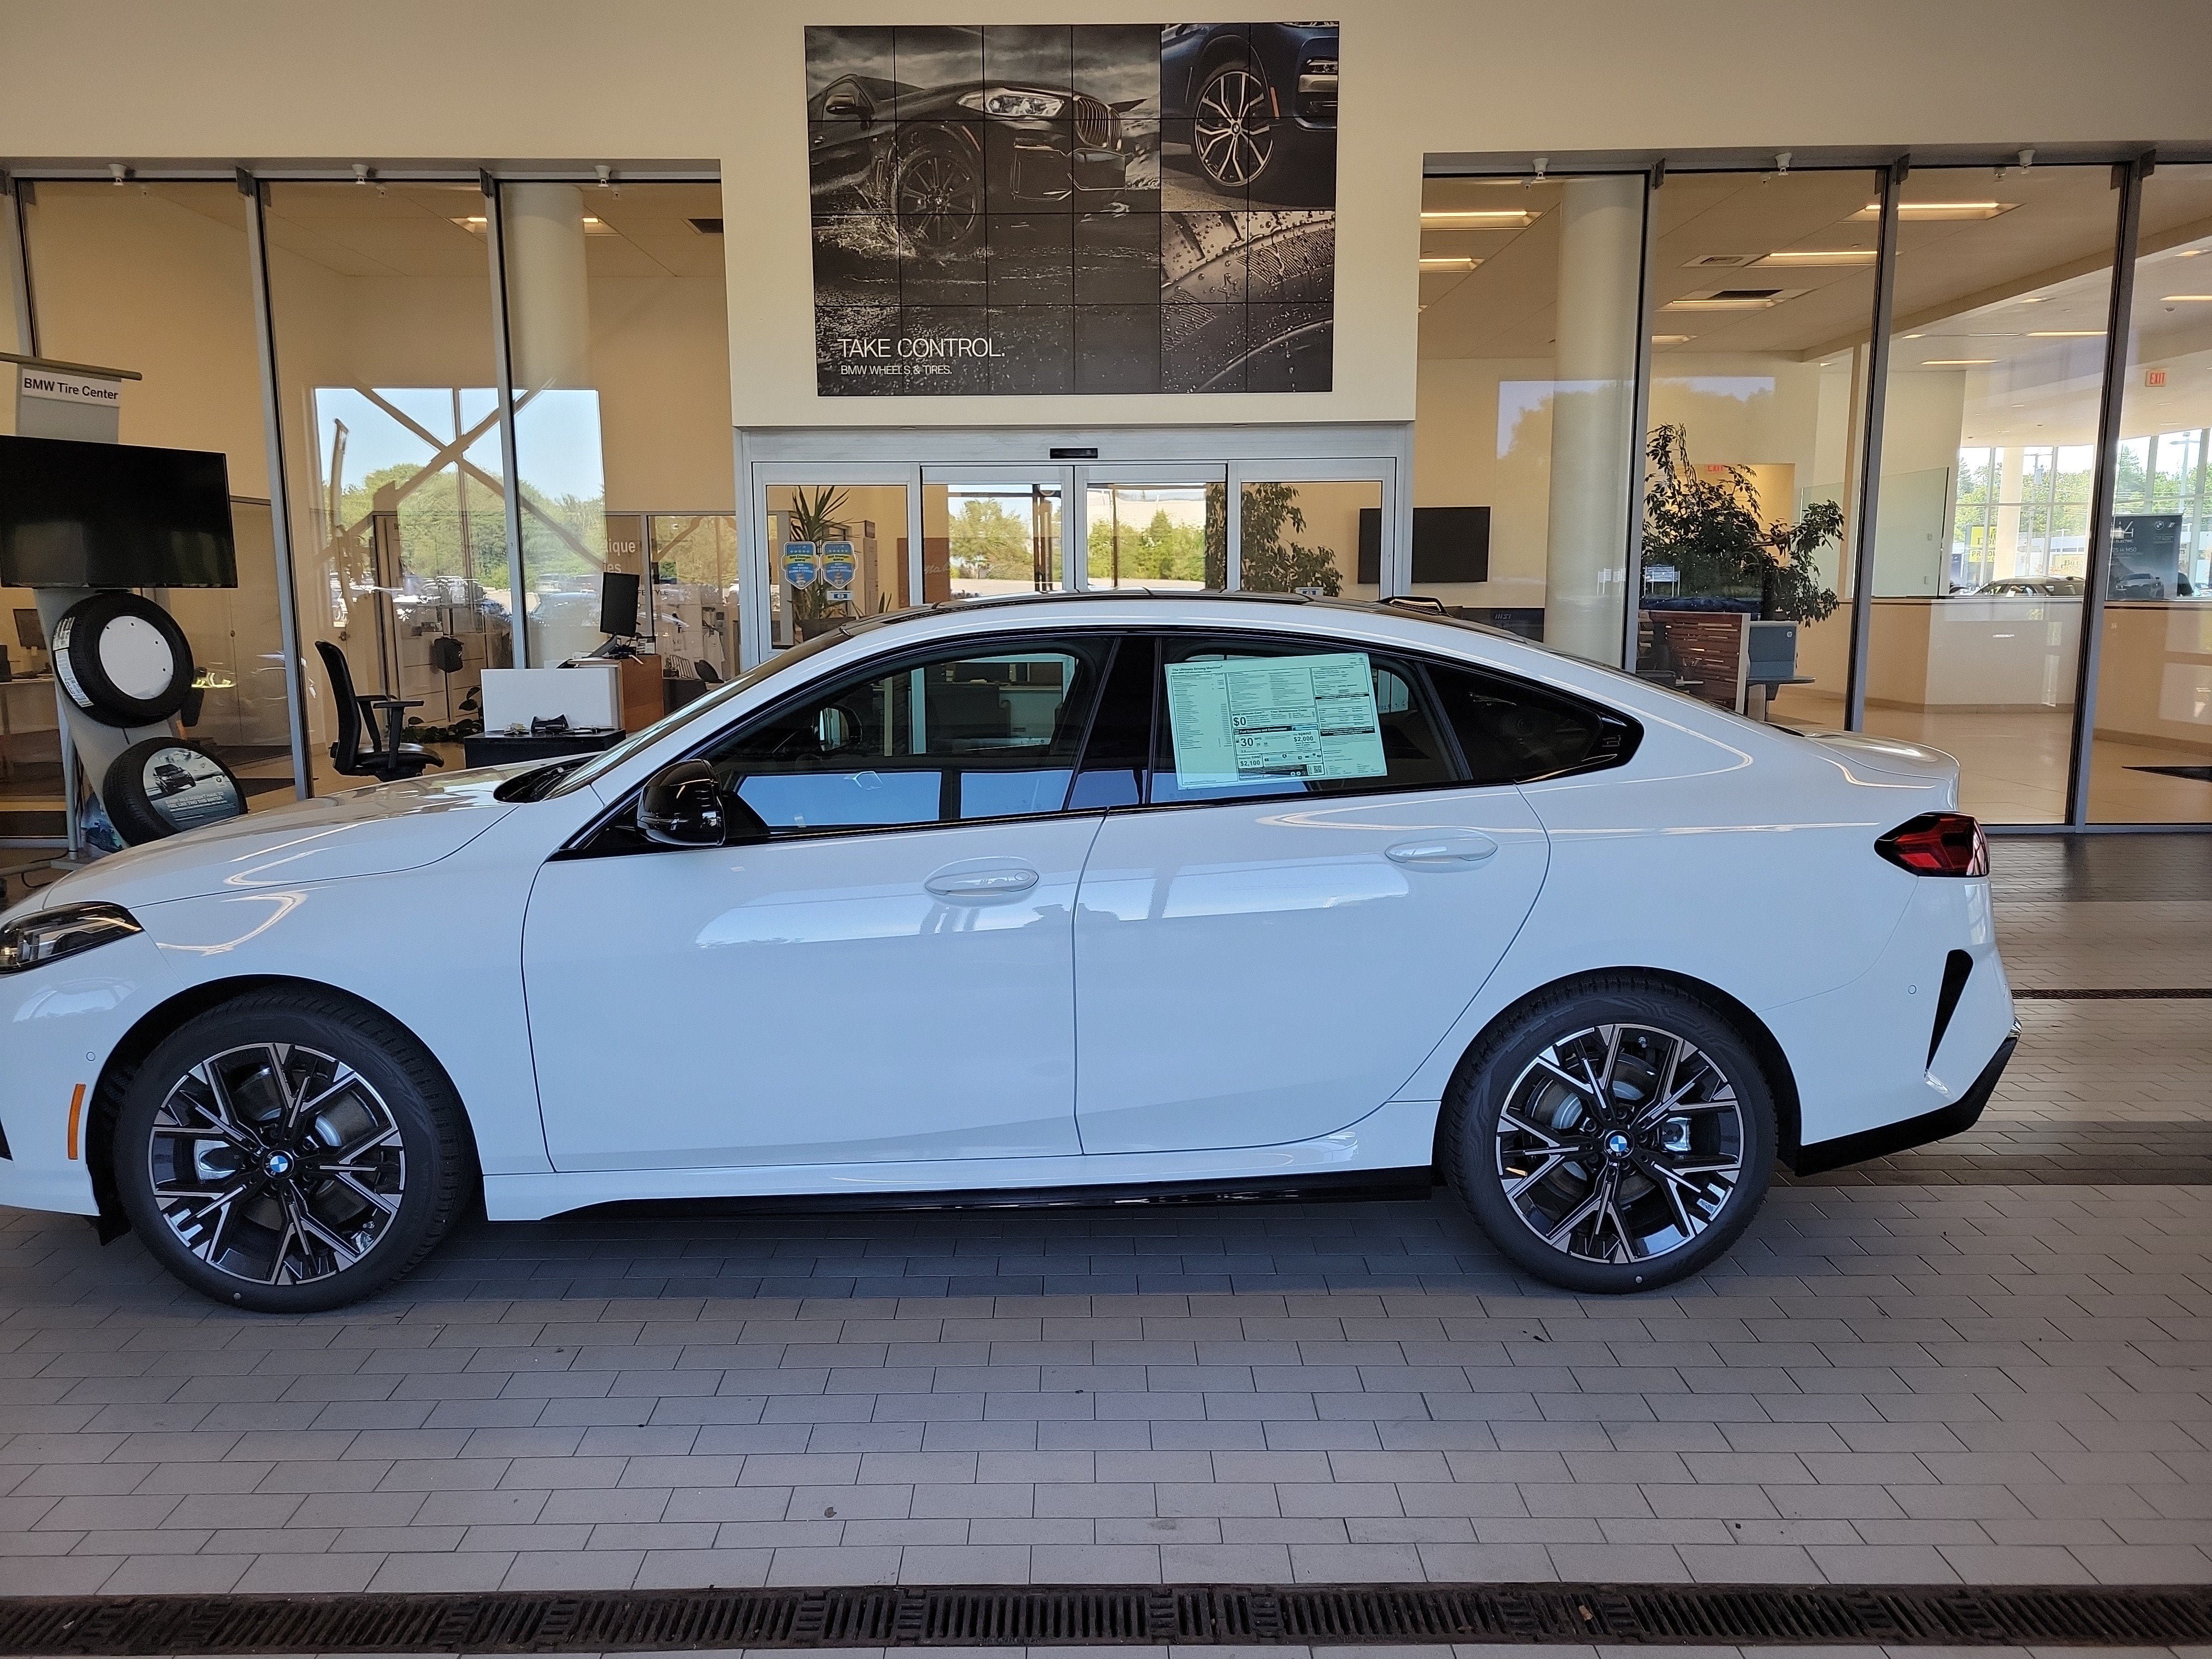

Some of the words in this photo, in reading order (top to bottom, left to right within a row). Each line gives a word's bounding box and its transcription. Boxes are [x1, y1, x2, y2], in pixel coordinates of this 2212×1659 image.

[837, 338, 891, 358] TAKE
[898, 337, 1006, 357] CONTROL.
[840, 365, 867, 375] BMW
[870, 365, 911, 375] WHEELS
[913, 365, 921, 375] &
[922, 365, 952, 375] TIRES.
[2150, 372, 2165, 384] EXIT
[24, 377, 55, 391] BMW
[57, 382, 79, 394] Tire
[82, 386, 119, 399] Center
[608, 538, 636, 557] ique
[1233, 716, 1246, 727] $0
[1240, 737, 1254, 747] 30
